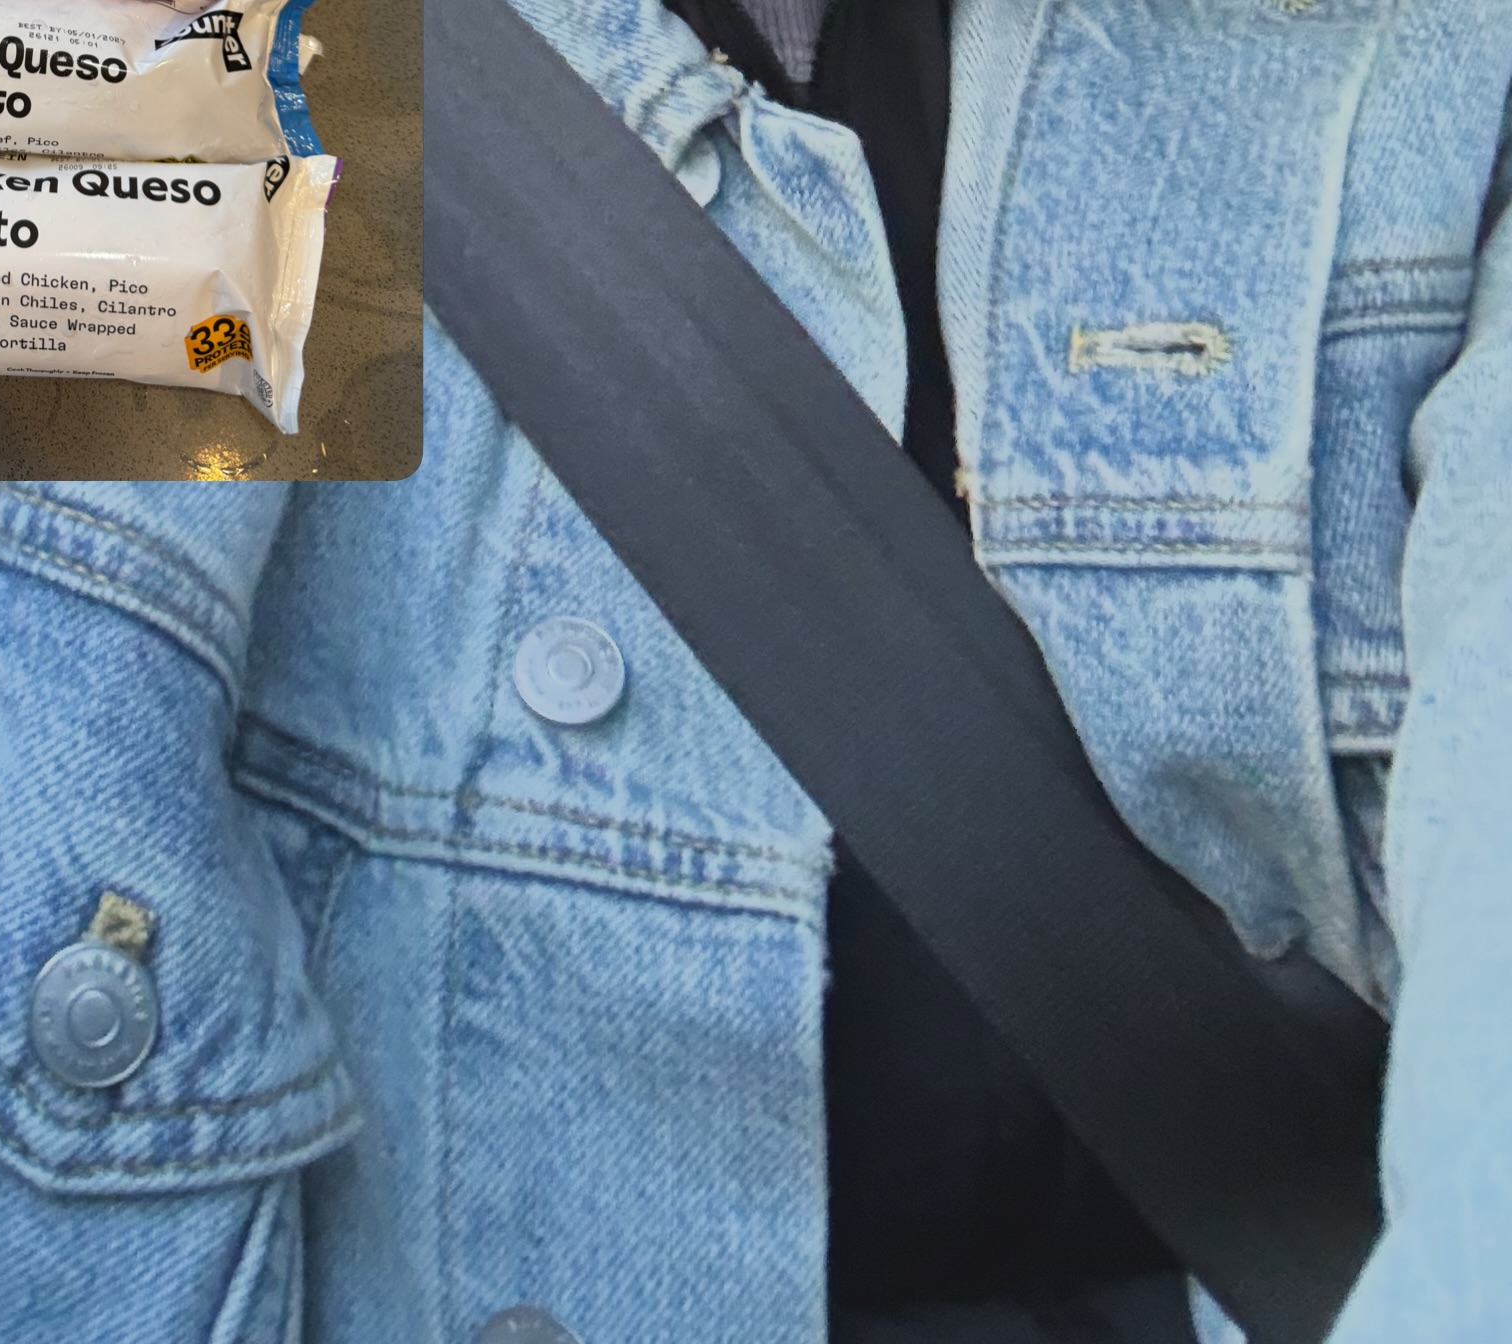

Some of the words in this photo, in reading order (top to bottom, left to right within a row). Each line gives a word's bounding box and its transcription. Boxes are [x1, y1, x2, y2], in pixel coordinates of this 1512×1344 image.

[18, 22, 43, 31] BEST
[27, 136, 60, 147] Pico
[72, 169, 222, 206] Queso
[20, 272, 96, 294] Chicken,
[109, 279, 149, 295] Pico
[19, 294, 86, 314] Chiles,
[97, 300, 177, 318] Cilantro
[10, 314, 58, 330] Sauce
[67, 319, 136, 337] Wrapped
